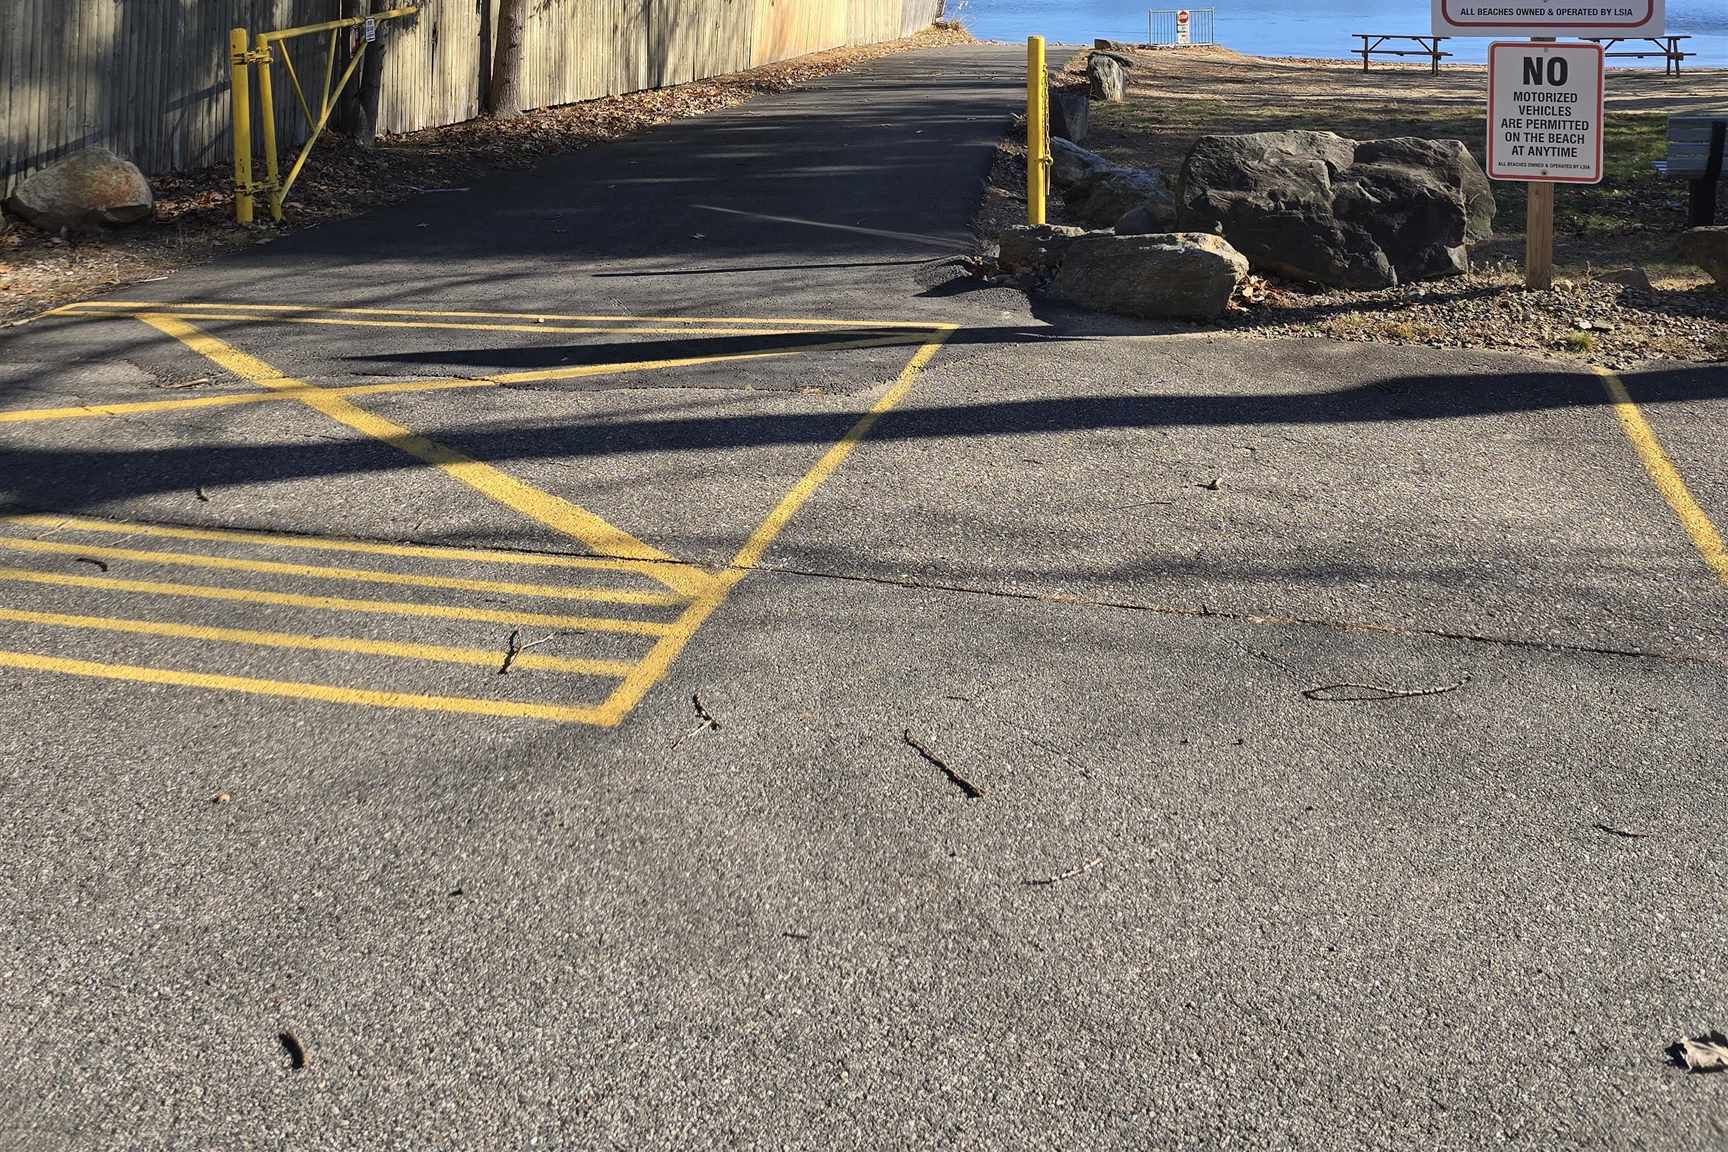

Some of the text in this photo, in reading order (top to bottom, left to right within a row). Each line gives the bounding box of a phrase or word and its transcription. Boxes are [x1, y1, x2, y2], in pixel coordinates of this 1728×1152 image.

[1523, 56, 1568, 86] NO
[1514, 92, 1577, 103] MOTORIZED
[1519, 106, 1572, 116] VEHICLES
[1501, 119, 1589, 130] ARE PERMITTED
[1505, 132, 1584, 144] ON THE BEACH
[1512, 146, 1577, 157] AT ANYTIME
